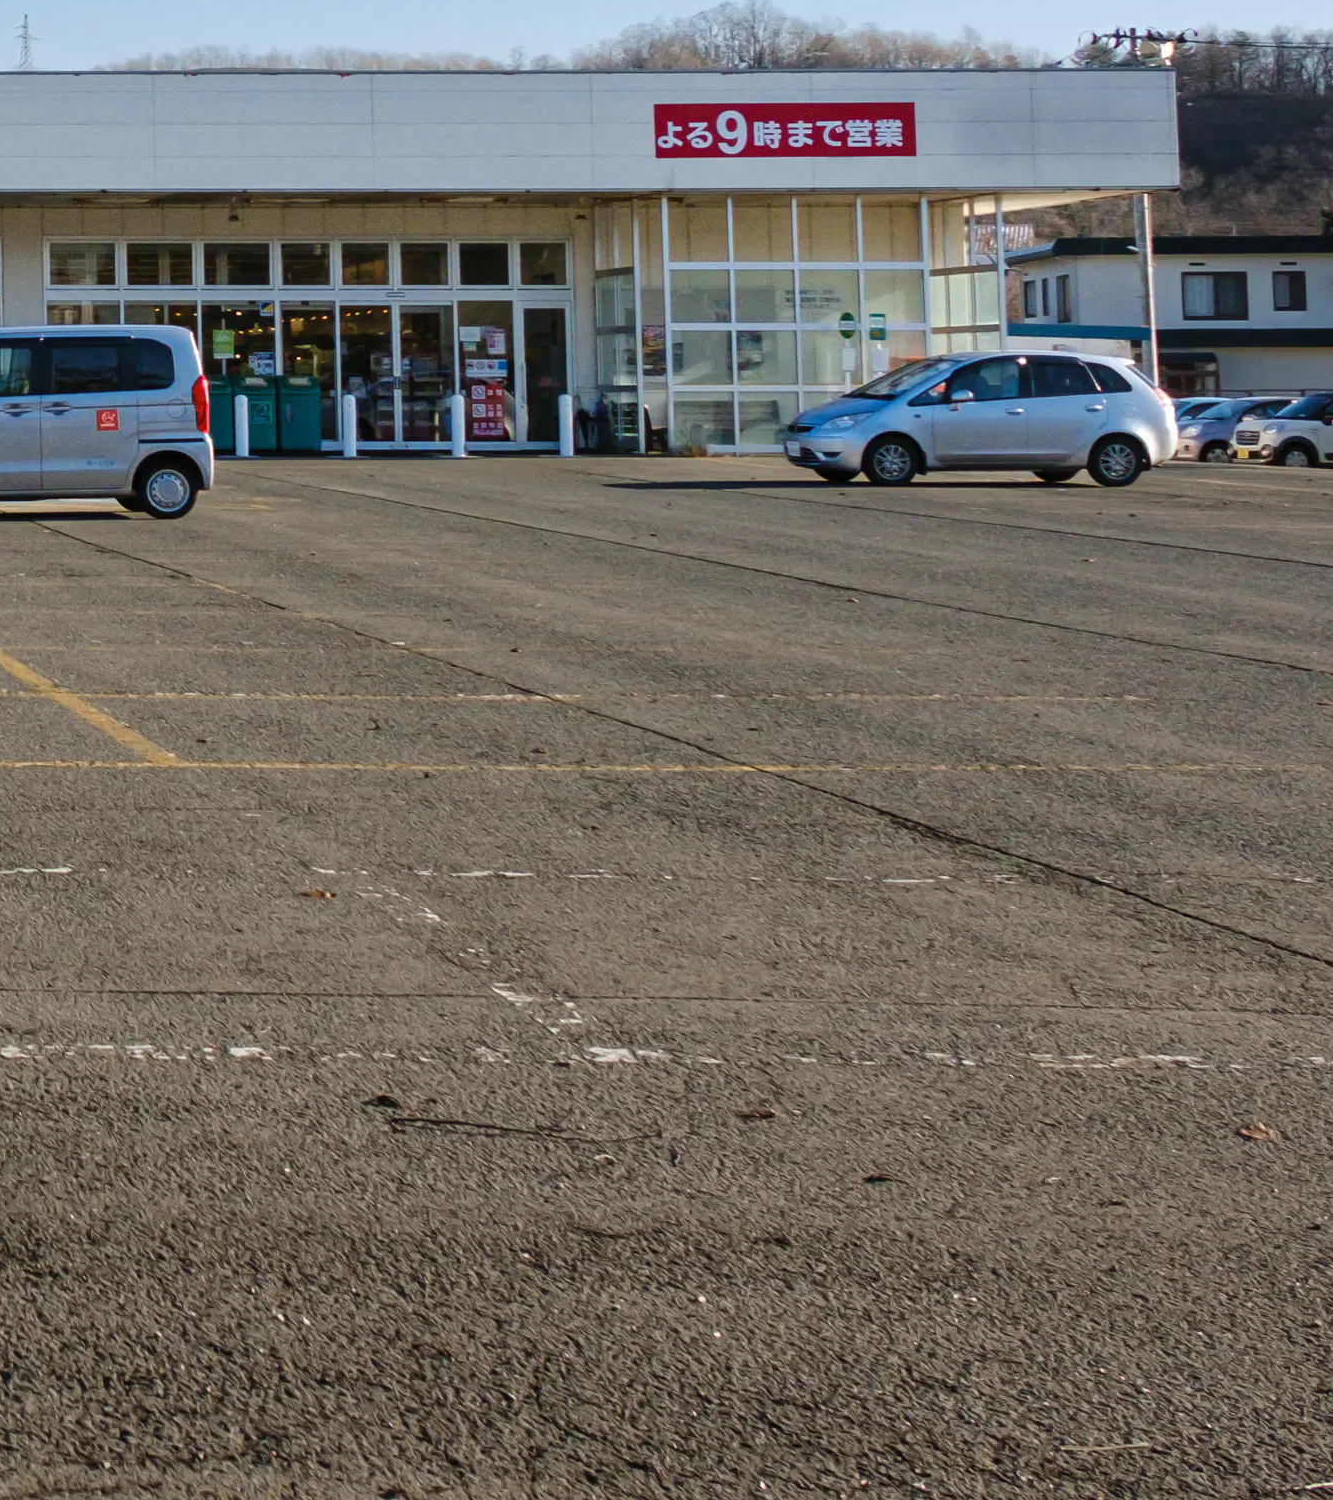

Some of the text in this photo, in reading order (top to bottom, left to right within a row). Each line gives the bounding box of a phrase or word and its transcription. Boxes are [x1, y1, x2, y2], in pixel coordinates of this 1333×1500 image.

[657, 110, 904, 154] よる9時まで営業
